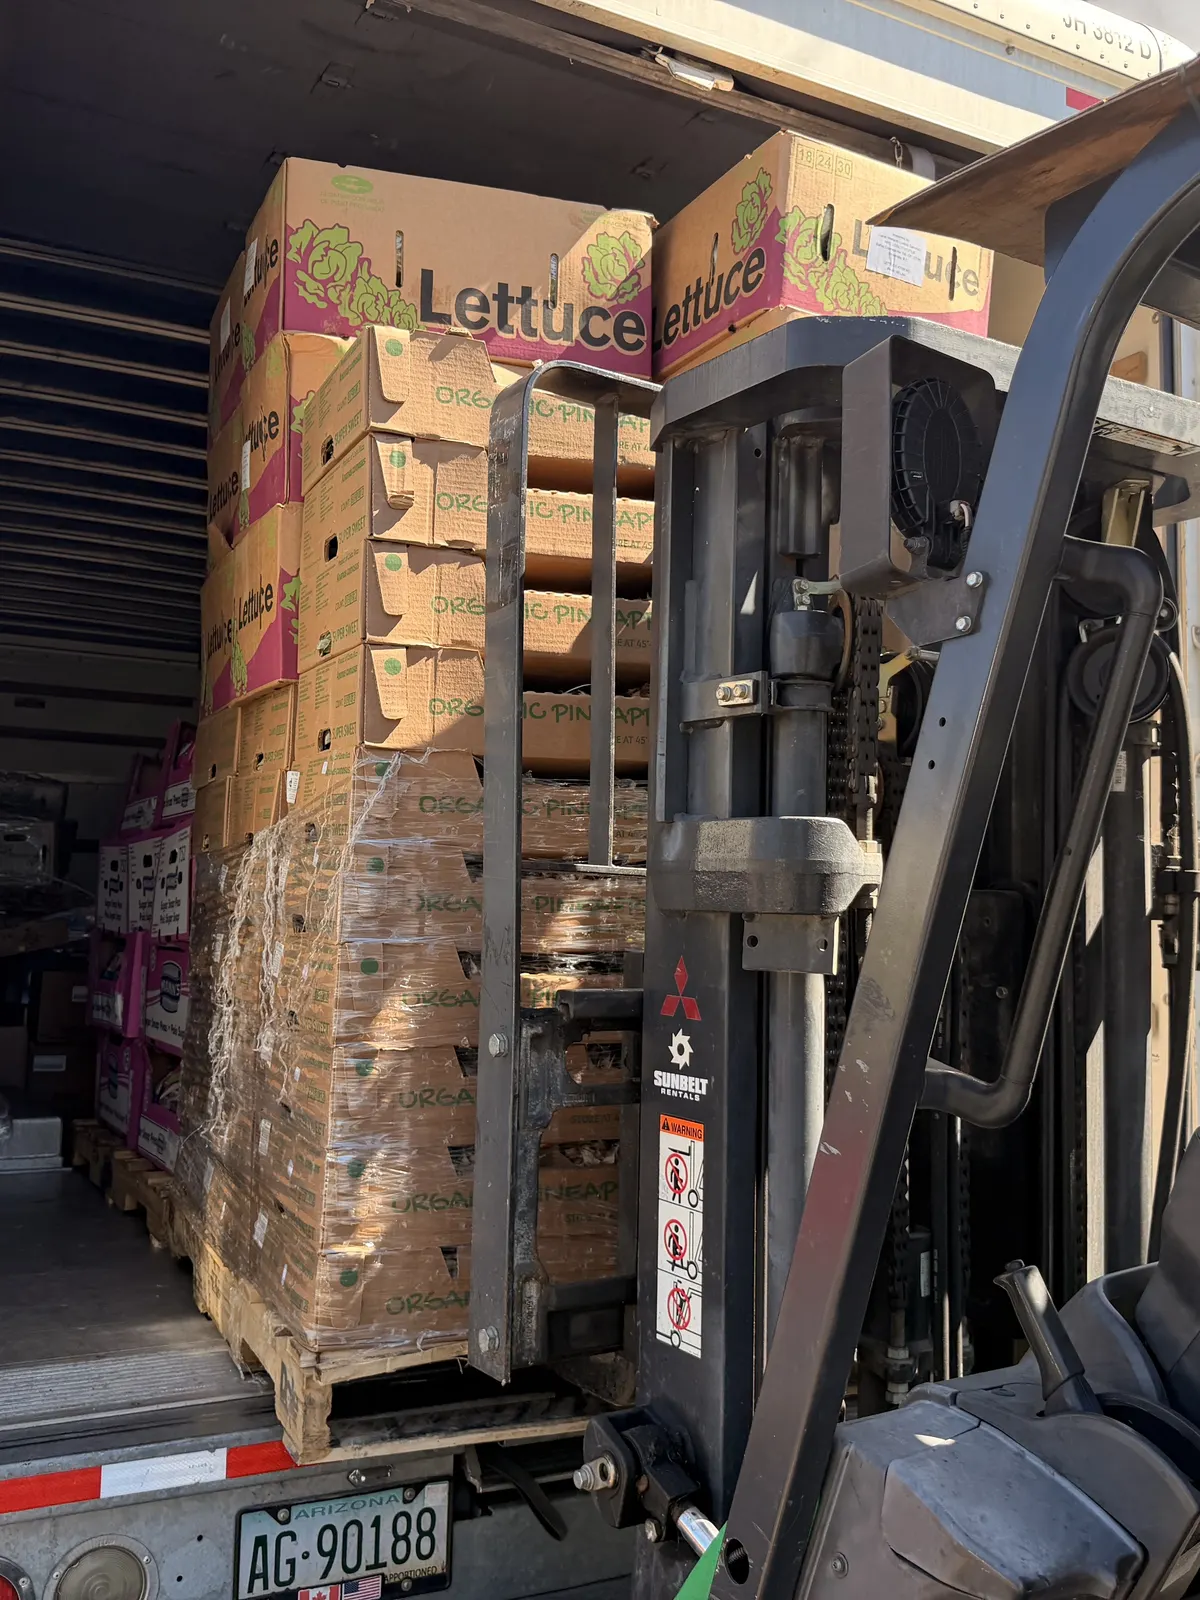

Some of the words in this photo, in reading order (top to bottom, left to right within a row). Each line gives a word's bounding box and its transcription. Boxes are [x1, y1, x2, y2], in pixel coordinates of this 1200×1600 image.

[798, 147, 813, 164] 18
[817, 153, 833, 171] 24
[837, 161, 852, 177] 30
[852, 218, 979, 297] Luce
[420, 268, 646, 352] Lettuce
[239, 583, 273, 631] Lettuce
[623, 638, 635, 648] AT
[622, 735, 634, 744] AT
[654, 1070, 709, 1095] SUNBELT
[660, 1087, 700, 1102] RENTALS
[670, 1122, 703, 1139] WARNING
[294, 1492, 401, 1521] ARIZONA
[384, 1565, 438, 1583] APPORTIONED
